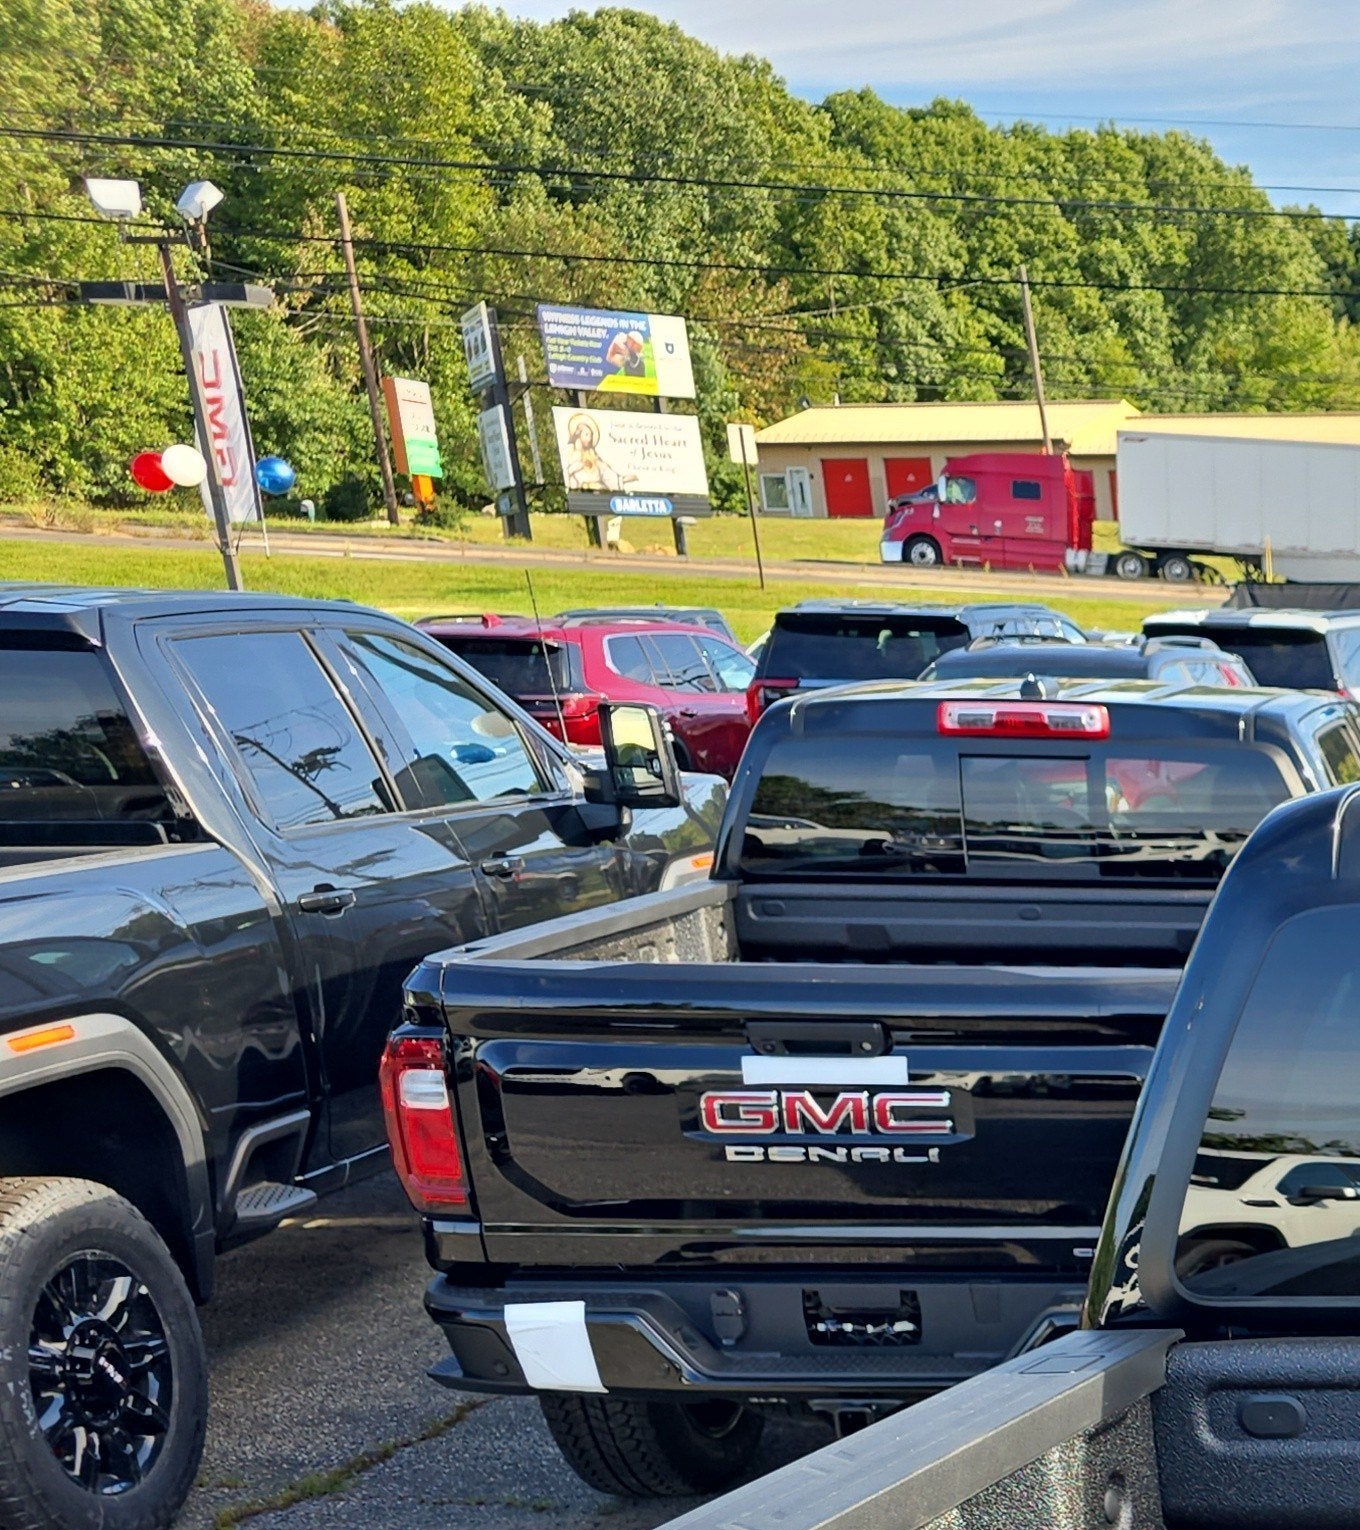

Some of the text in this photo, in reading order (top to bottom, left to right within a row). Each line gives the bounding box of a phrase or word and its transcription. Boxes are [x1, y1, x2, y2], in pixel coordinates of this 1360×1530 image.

[580, 315, 618, 329] LEGENDS
[619, 319, 629, 330] IN
[630, 320, 647, 331] THE
[608, 433, 688, 447] Sacred Heart
[642, 446, 672, 460] Jesus
[700, 1089, 954, 1136] GMC
[724, 1145, 940, 1163] DENALI
